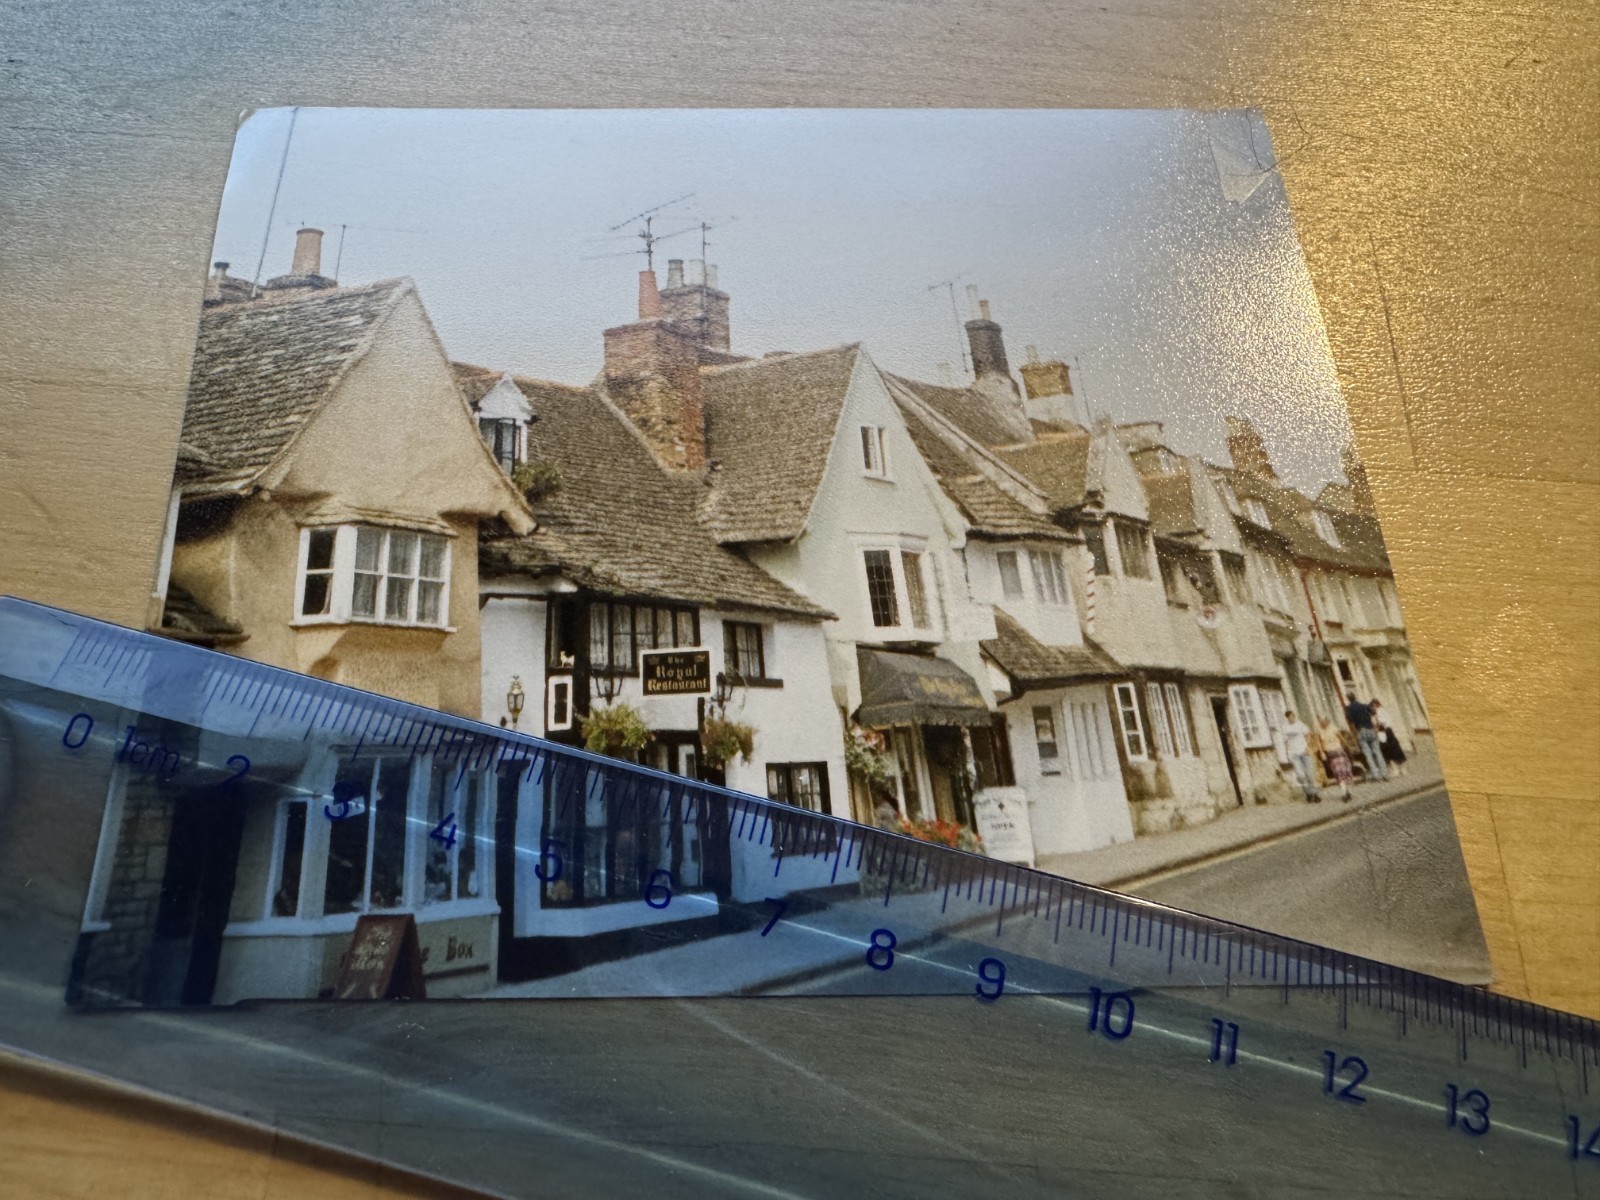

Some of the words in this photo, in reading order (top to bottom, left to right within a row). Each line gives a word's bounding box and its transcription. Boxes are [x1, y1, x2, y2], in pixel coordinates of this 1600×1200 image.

[656, 664, 698, 680] Royal
[647, 677, 708, 691] Restaurant
[63, 713, 94, 749] 0
[219, 754, 251, 788] 2
[324, 783, 357, 819] 3
[429, 812, 457, 849] 4
[534, 839, 564, 882] 5
[644, 870, 672, 909] 6
[761, 898, 788, 937] 7
[866, 928, 896, 971] 8
[975, 958, 1005, 999] 9
[1088, 987, 1135, 1039] 10
[1211, 1018, 1240, 1065] 11
[1324, 1050, 1369, 1102] 12
[1447, 1083, 1490, 1135] 13
[446, 936, 473, 962] Box
